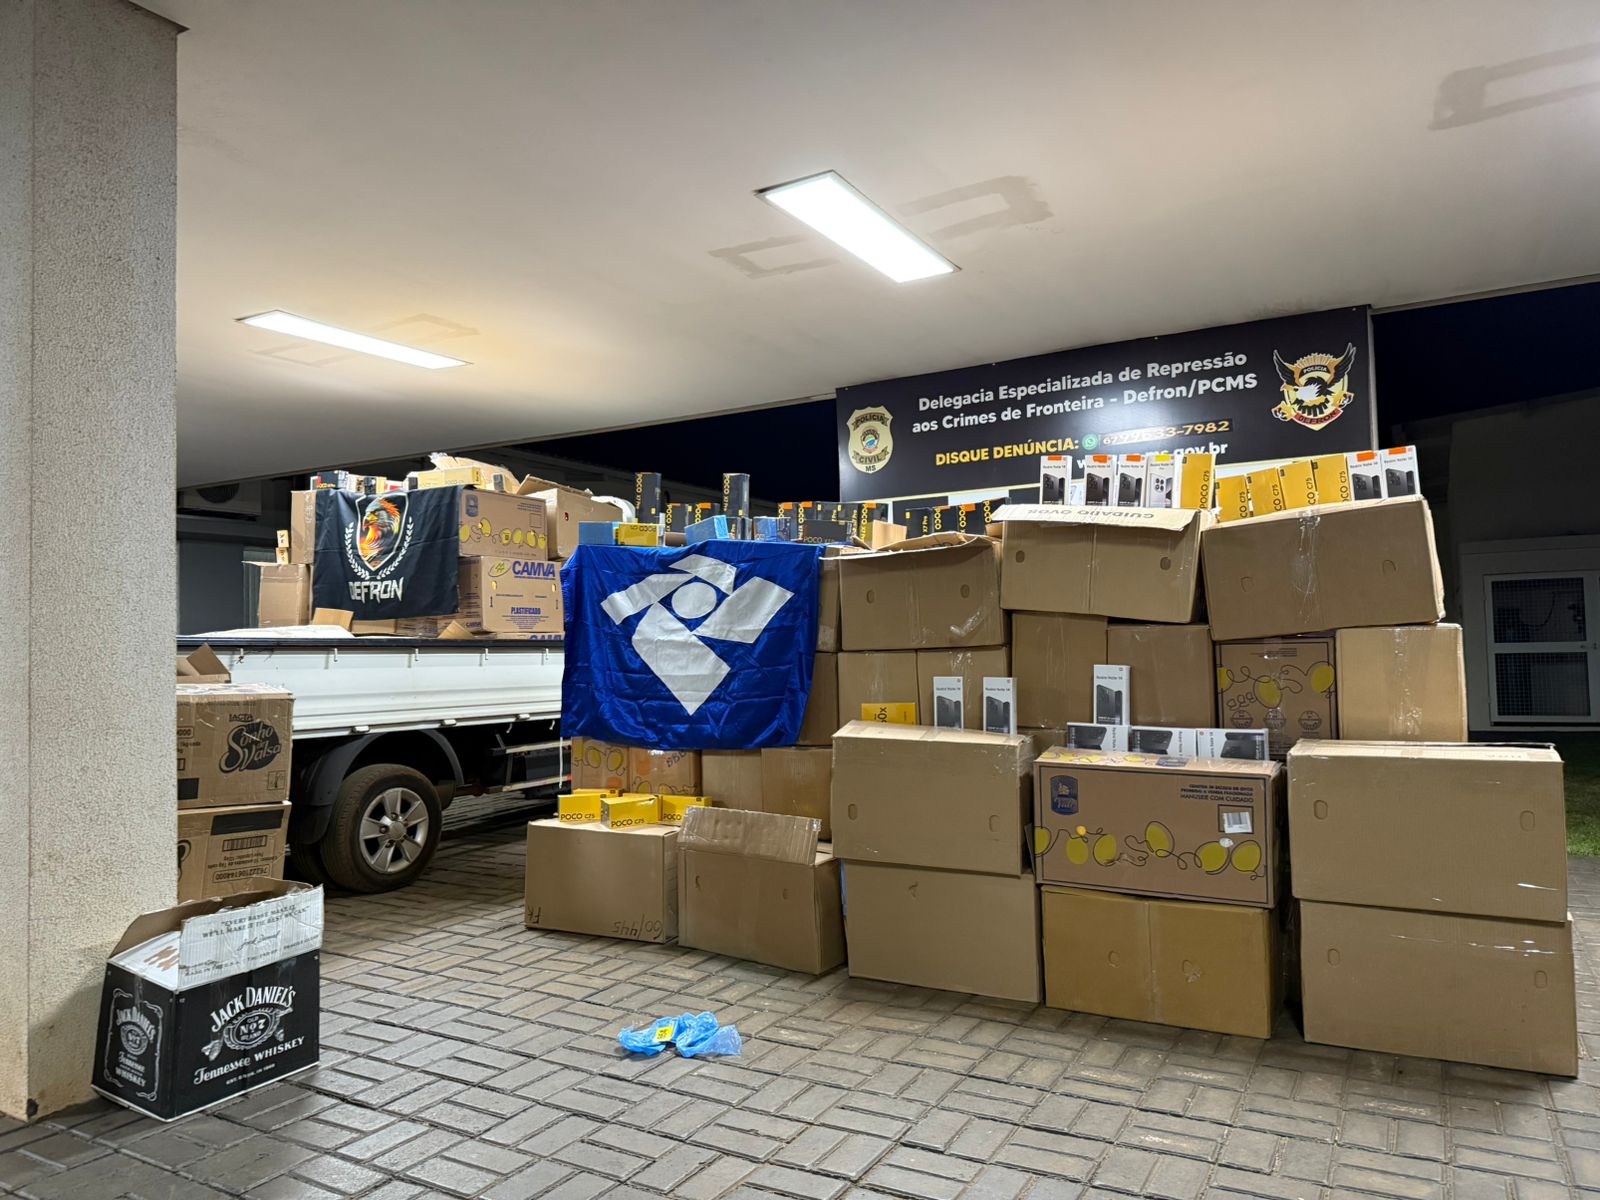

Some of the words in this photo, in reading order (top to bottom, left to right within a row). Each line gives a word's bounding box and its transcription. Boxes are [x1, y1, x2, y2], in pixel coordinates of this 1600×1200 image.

[918, 387, 994, 411] Delegacia
[998, 371, 1113, 400] Especializada
[1118, 366, 1142, 382] de
[1147, 352, 1247, 379] Repressão
[912, 420, 938, 433] aos
[942, 411, 997, 429] Crimes
[1000, 407, 1022, 421] de
[1026, 396, 1104, 418] Fronteira
[1123, 373, 1258, 405] Defron/PCMS
[859, 454, 881, 463] CIVIL
[935, 448, 989, 466] DISQUE
[993, 437, 1079, 460] DENÚNCIA:
[1199, 484, 1209, 509] POCO
[512, 561, 555, 577] CAMVA
[239, 741, 282, 772] Valsa
[560, 813, 583, 821] POCO
[611, 819, 633, 827] POCO
[663, 813, 682, 821] POCO
[210, 994, 245, 1032] JACK
[193, 1057, 251, 1085] Tennessee
[254, 1035, 305, 1062] WHISKEY
